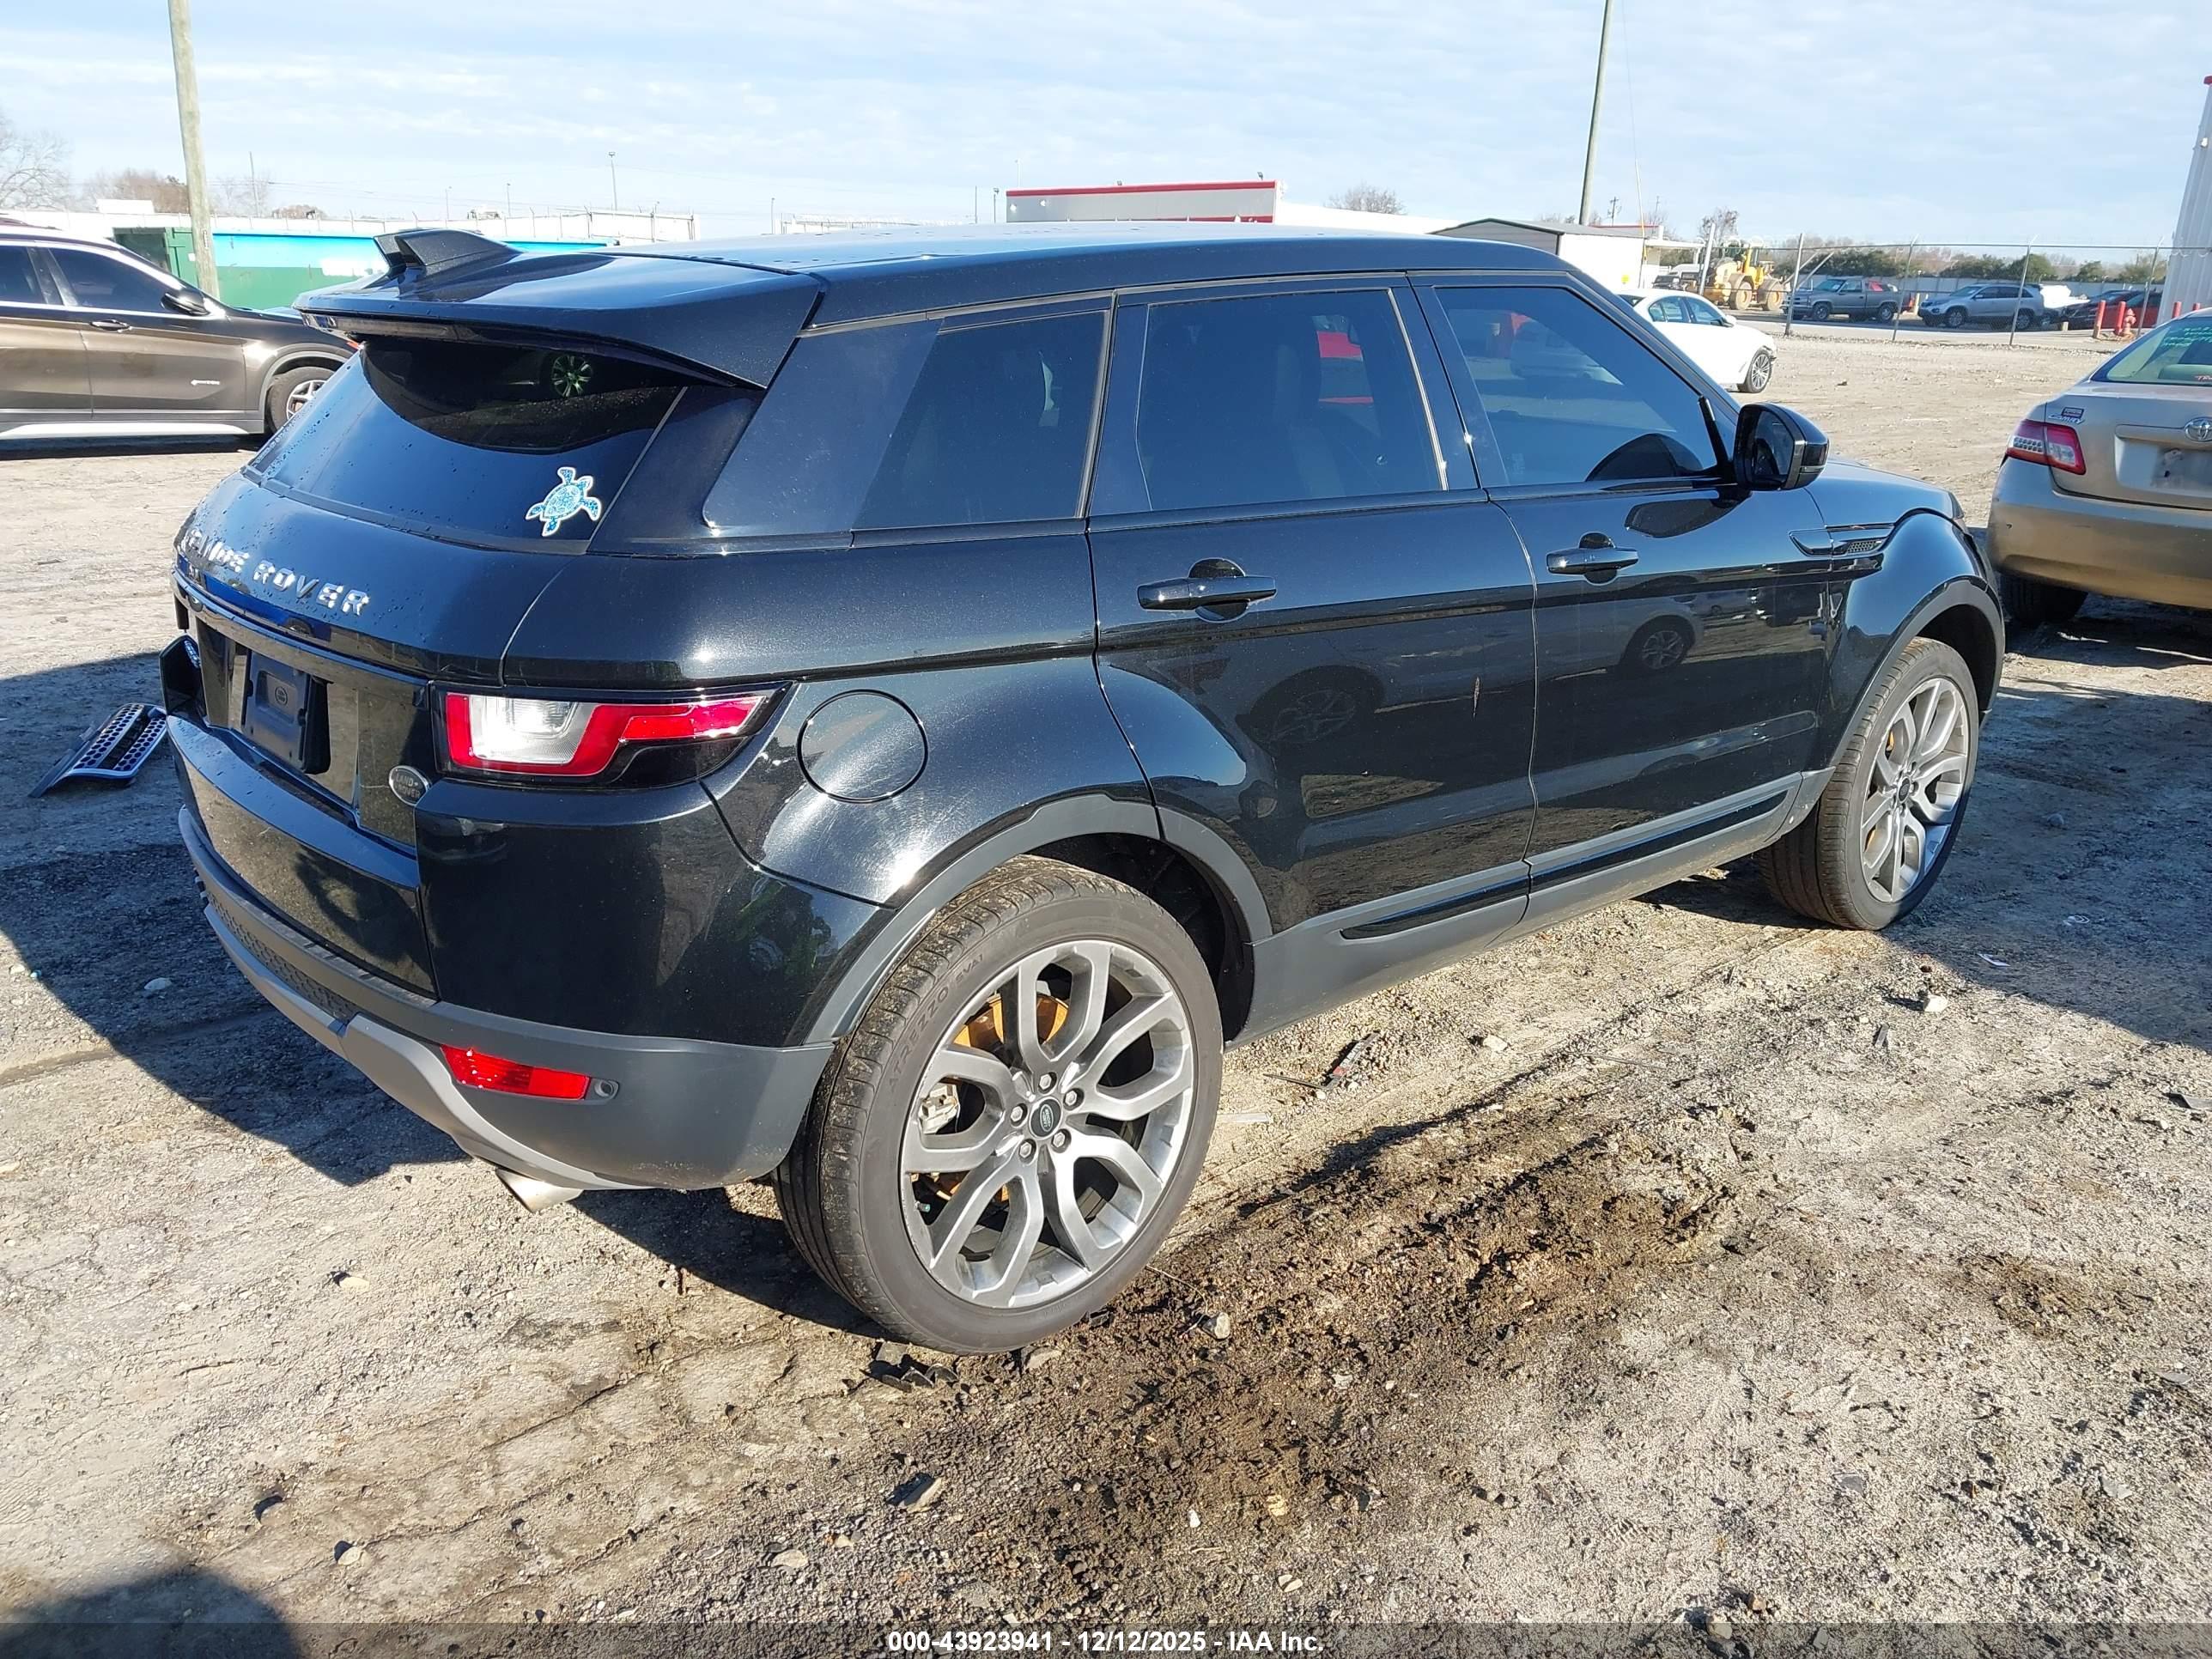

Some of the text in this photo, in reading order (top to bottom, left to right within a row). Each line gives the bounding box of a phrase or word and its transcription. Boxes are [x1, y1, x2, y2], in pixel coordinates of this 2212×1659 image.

[253, 560, 371, 616] ROVER
[396, 773, 414, 787] LAND
[398, 784, 421, 799] ROVER
